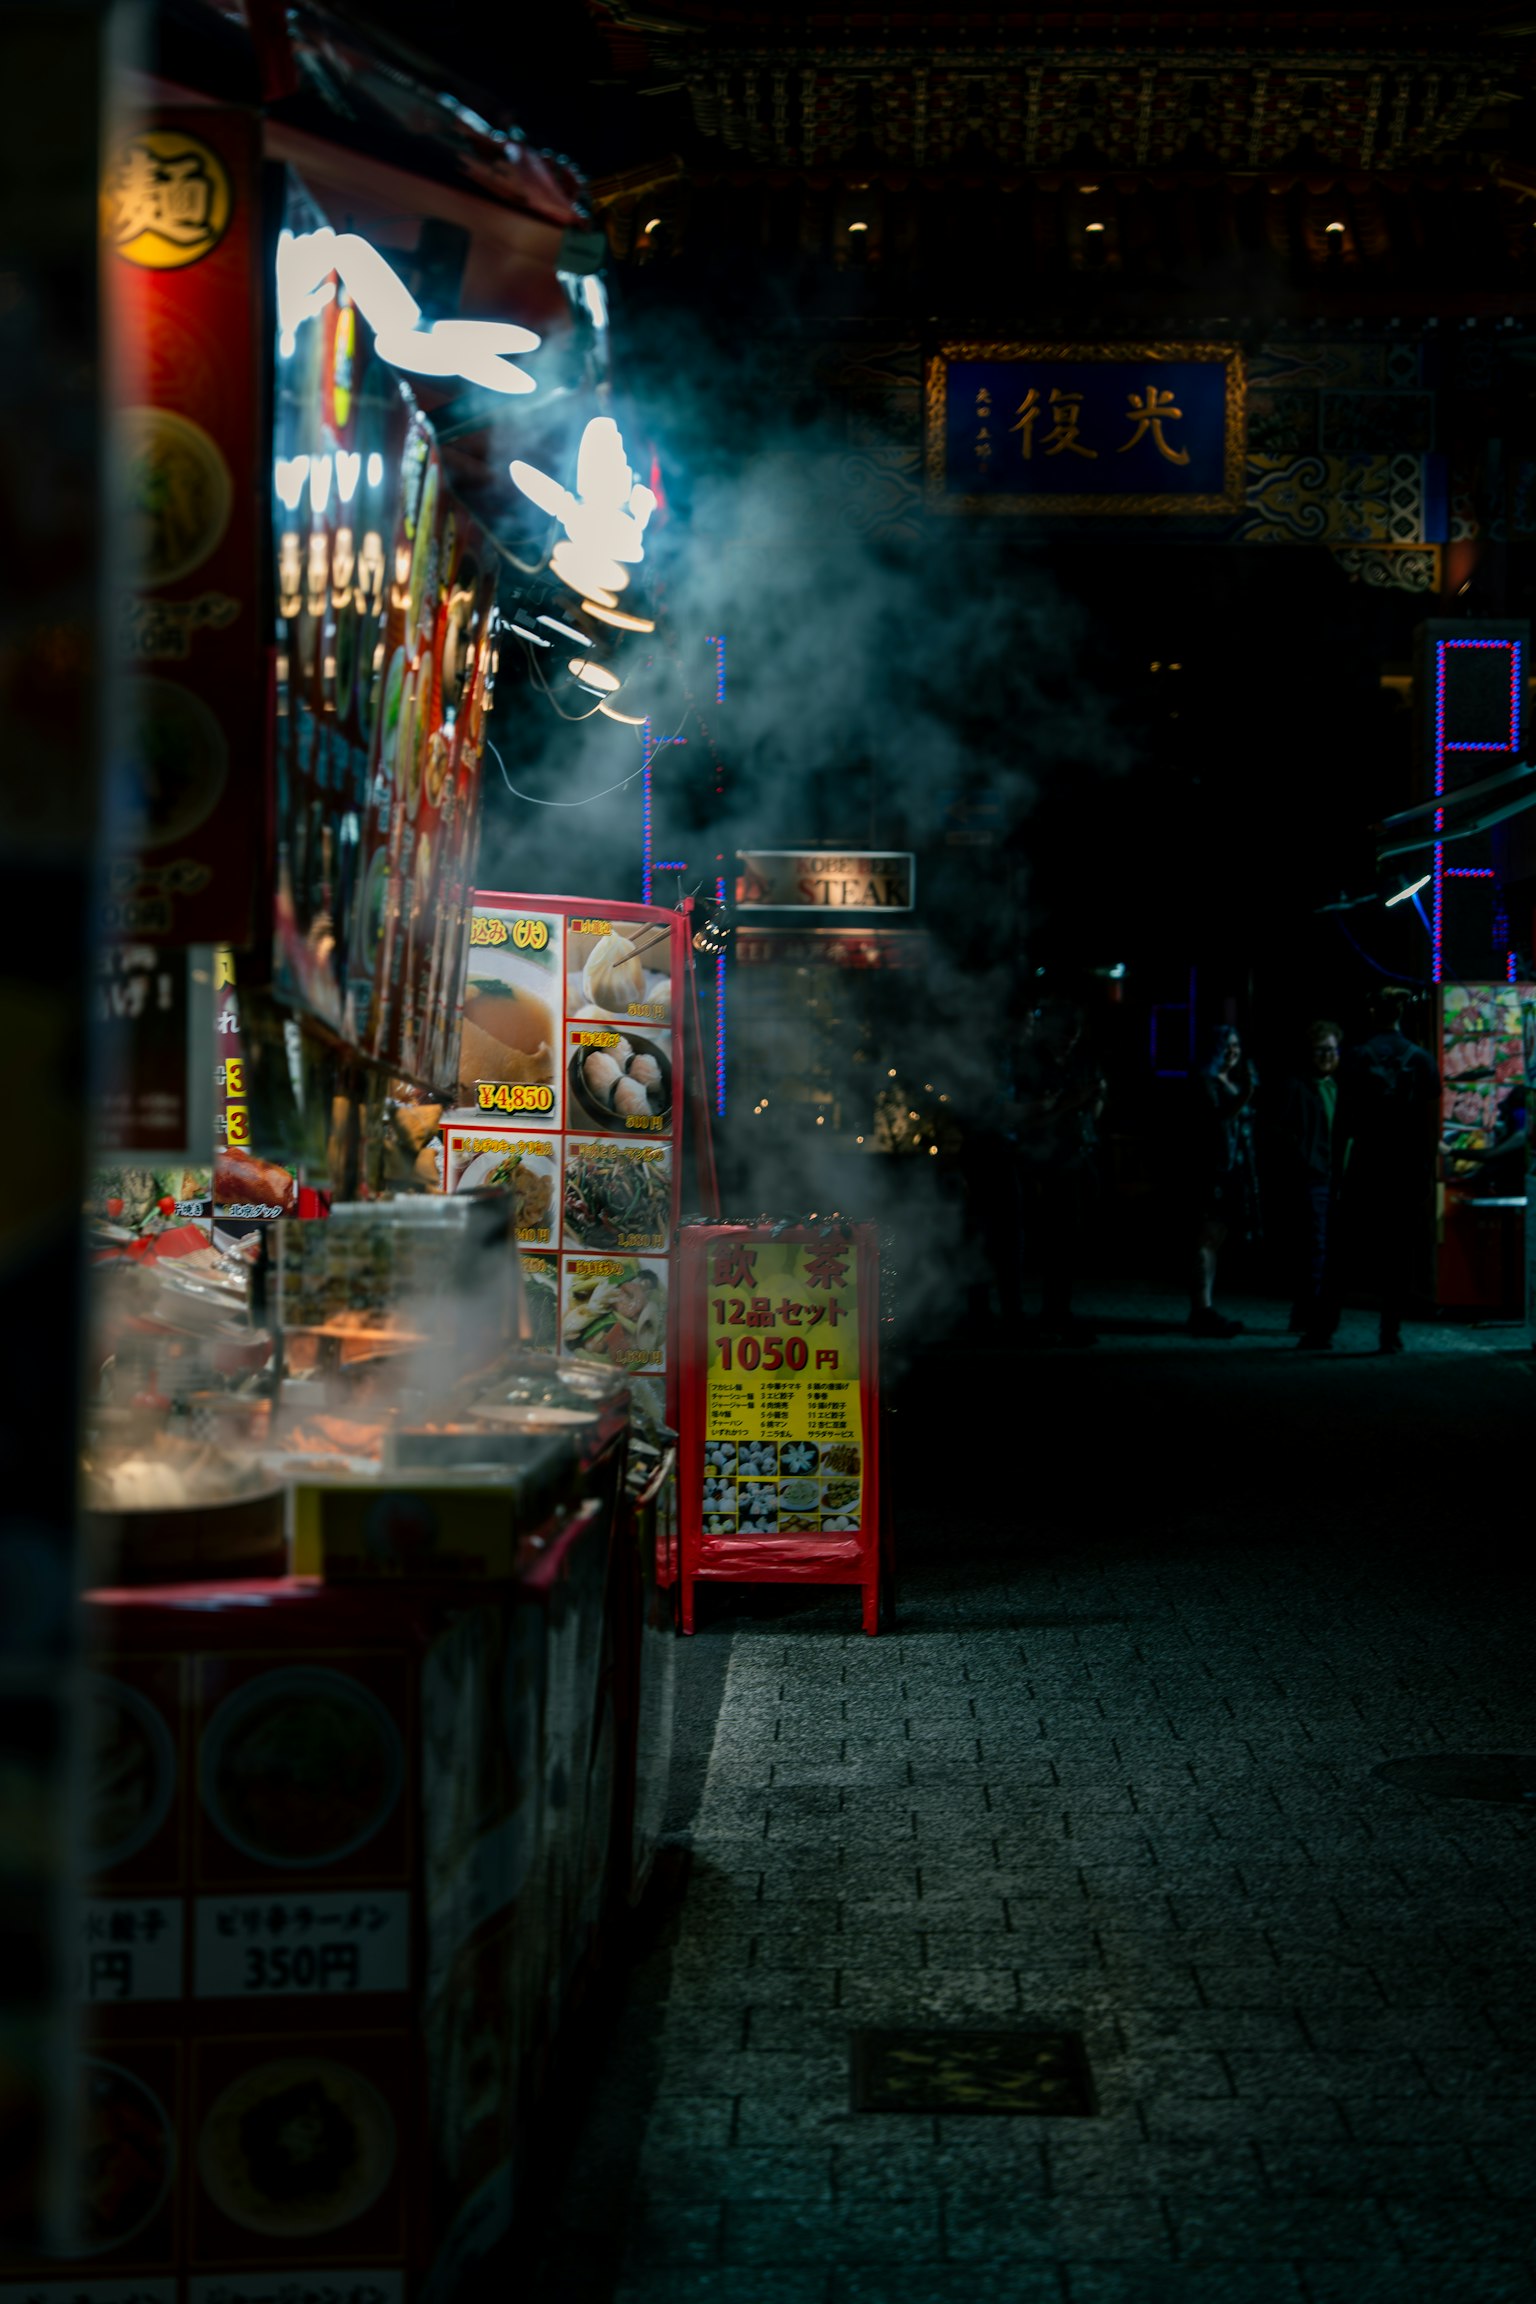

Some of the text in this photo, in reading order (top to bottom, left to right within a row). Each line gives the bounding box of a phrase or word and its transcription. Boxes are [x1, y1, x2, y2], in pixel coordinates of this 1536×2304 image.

[797, 878, 907, 906] STEAK
[478, 1084, 552, 1111] ¥4,850
[229, 1203, 283, 1219] 北京ダック
[712, 1297, 848, 1327] 12品セット
[245, 1943, 359, 1989] 350円
